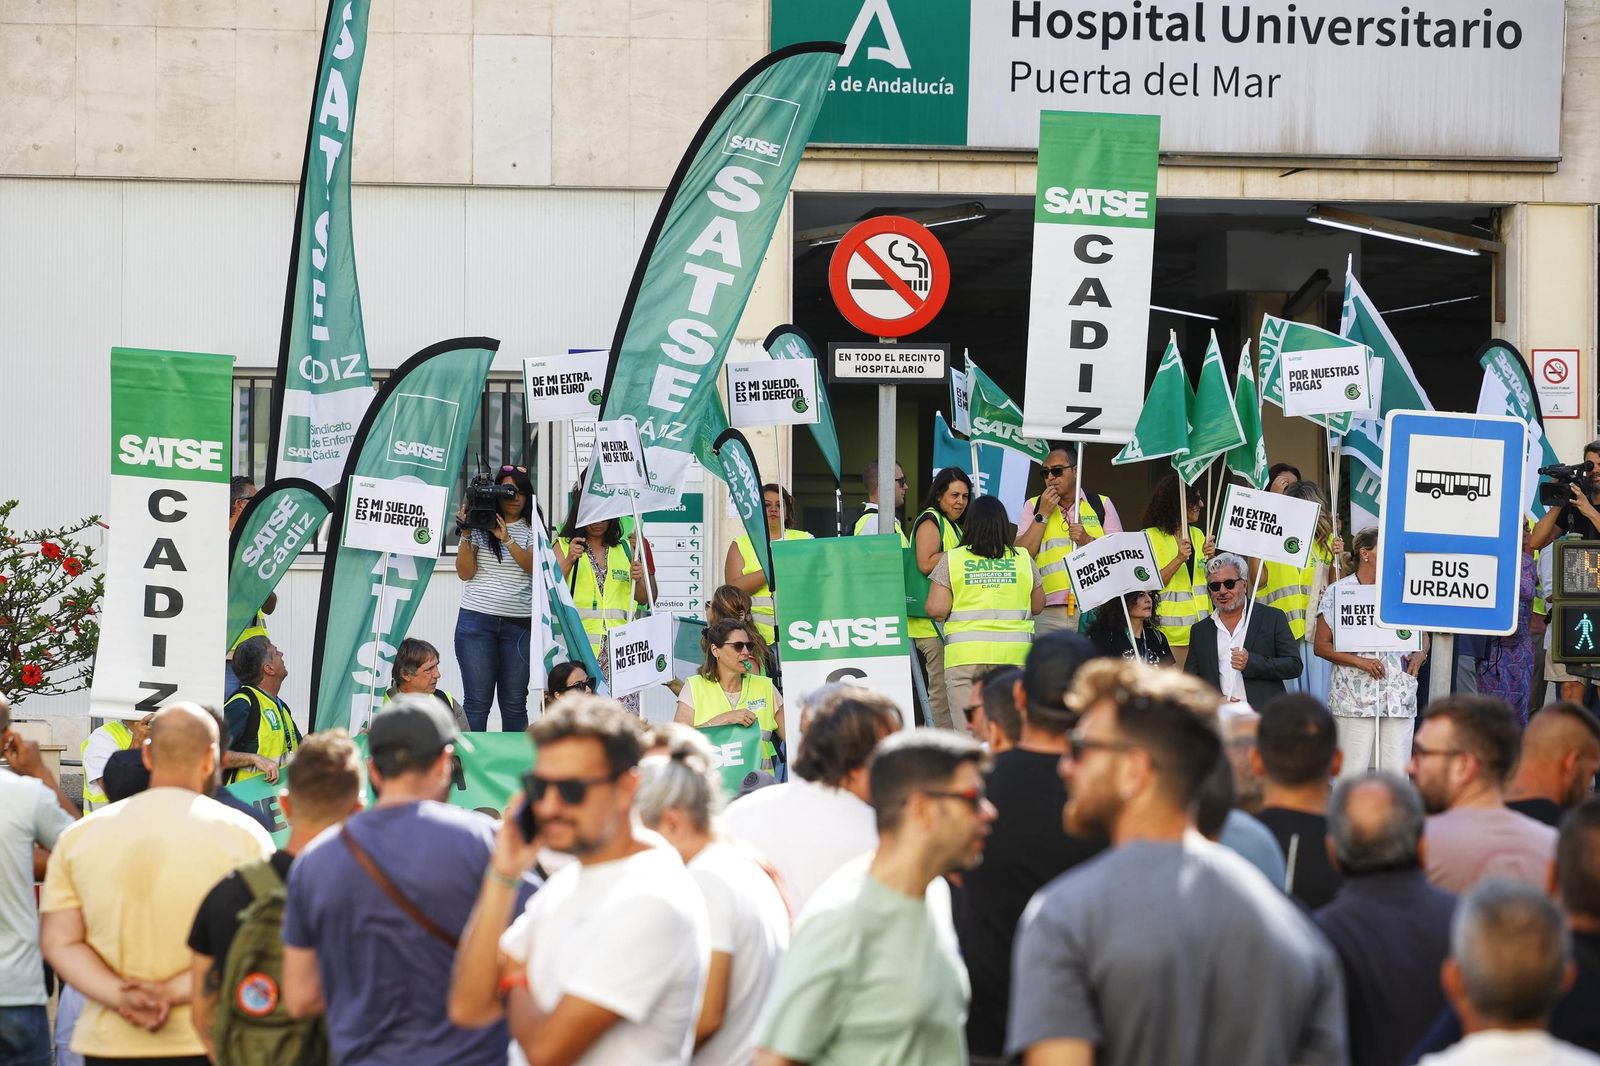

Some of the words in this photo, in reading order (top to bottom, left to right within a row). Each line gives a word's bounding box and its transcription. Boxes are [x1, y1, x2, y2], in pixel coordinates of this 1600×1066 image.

[1011, 0, 1206, 50] Hospital
[1220, 3, 1524, 50] Universitario
[841, 76, 863, 93] de
[866, 76, 955, 95] Andalucía
[1010, 60, 1132, 97] Puerta
[1143, 62, 1200, 98] del
[1212, 65, 1282, 99] Mar
[729, 134, 781, 158] SATSE
[1043, 186, 1149, 219] SATSE
[647, 165, 765, 413] SATSE
[1061, 234, 1114, 436] CADIZ
[839, 353, 851, 362] EN
[855, 353, 881, 362] TODO
[885, 353, 896, 362] EL
[899, 353, 941, 362] RECINTO
[299, 353, 365, 384] CDIZ
[855, 365, 925, 374] HOSPITALARIO
[1288, 369, 1309, 381] POR
[1311, 365, 1360, 380] NUESTRAS
[532, 376, 544, 387] DE
[546, 375, 558, 386] MI
[533, 386, 544, 397] NI
[545, 385, 559, 396] UN
[561, 383, 585, 395] EURO
[735, 381, 746, 392] ES
[748, 380, 760, 391] MI
[762, 378, 800, 391] SUELDO,
[1289, 379, 1322, 392] PAGAS
[735, 391, 747, 403] ES
[749, 390, 760, 402] MI
[762, 389, 804, 401] DERECHO
[311, 421, 352, 435] Sindicato
[311, 437, 321, 448] de
[393, 440, 446, 463] SATSE
[601, 441, 610, 452] MI
[610, 440, 629, 452] EXTRA
[118, 434, 223, 472] SATSE
[312, 449, 341, 461] Cádiz
[603, 452, 612, 463] NO
[612, 452, 620, 462] SE
[619, 451, 635, 462] TOCA
[356, 497, 369, 509] ES
[370, 499, 383, 511] MI
[385, 501, 426, 517] SUELDO,
[1231, 505, 1244, 517] MI
[1245, 508, 1277, 524] EXTRA
[355, 508, 367, 521] ES
[369, 511, 382, 523] MI
[383, 514, 429, 528] DERECHO
[1229, 516, 1244, 528] NO
[1245, 519, 1258, 531] SE
[1260, 522, 1283, 537] TOCA
[242, 494, 300, 568] SATSE
[257, 512, 316, 581] Cádiz
[964, 558, 1016, 572] SATSE
[1076, 562, 1096, 580] POR
[1095, 549, 1144, 569] NUESTRAS
[1431, 560, 1469, 578] BUS
[1079, 566, 1110, 589] PAGAS
[1410, 579, 1489, 600] URBANO
[134, 488, 188, 713] CADIZ
[655, 600, 684, 608] gnóstico
[1341, 604, 1352, 615] MI
[1354, 604, 1375, 615] EXTR
[1341, 615, 1354, 626] NO
[1356, 615, 1367, 626] SE
[788, 616, 901, 650] SATSE
[615, 646, 624, 659] MI
[625, 639, 649, 656] EXTRA
[616, 657, 626, 670] NO
[627, 654, 636, 667] SE
[637, 649, 654, 664] TOCA
